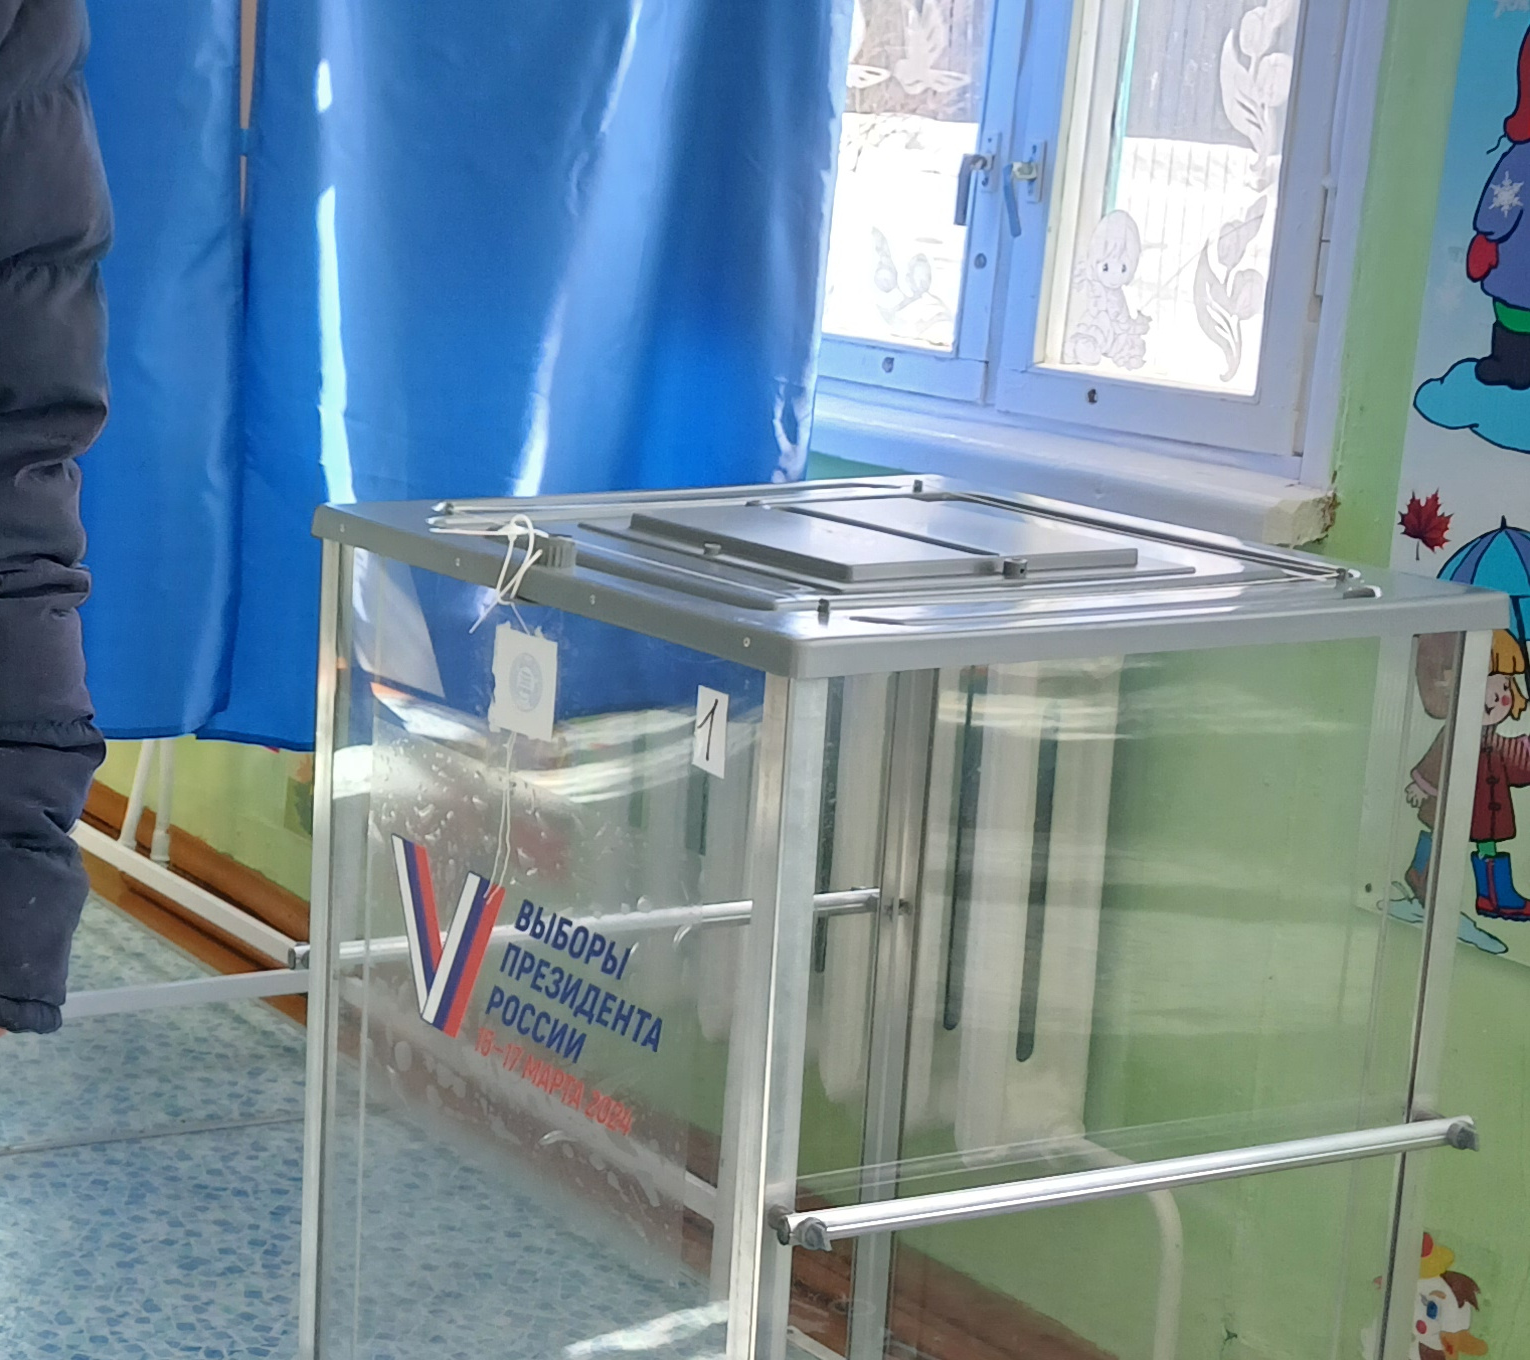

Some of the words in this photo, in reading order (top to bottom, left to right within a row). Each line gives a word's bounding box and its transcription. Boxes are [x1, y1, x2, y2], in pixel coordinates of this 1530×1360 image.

[697, 698, 719, 762] 1
[514, 898, 632, 980] ВЫБОРЫ
[484, 984, 589, 1064] РОССИИ
[499, 941, 664, 1053] ПРЕЗИДЕНТА
[521, 1054, 585, 1112] МАРТА
[583, 1089, 634, 1137] 2024
